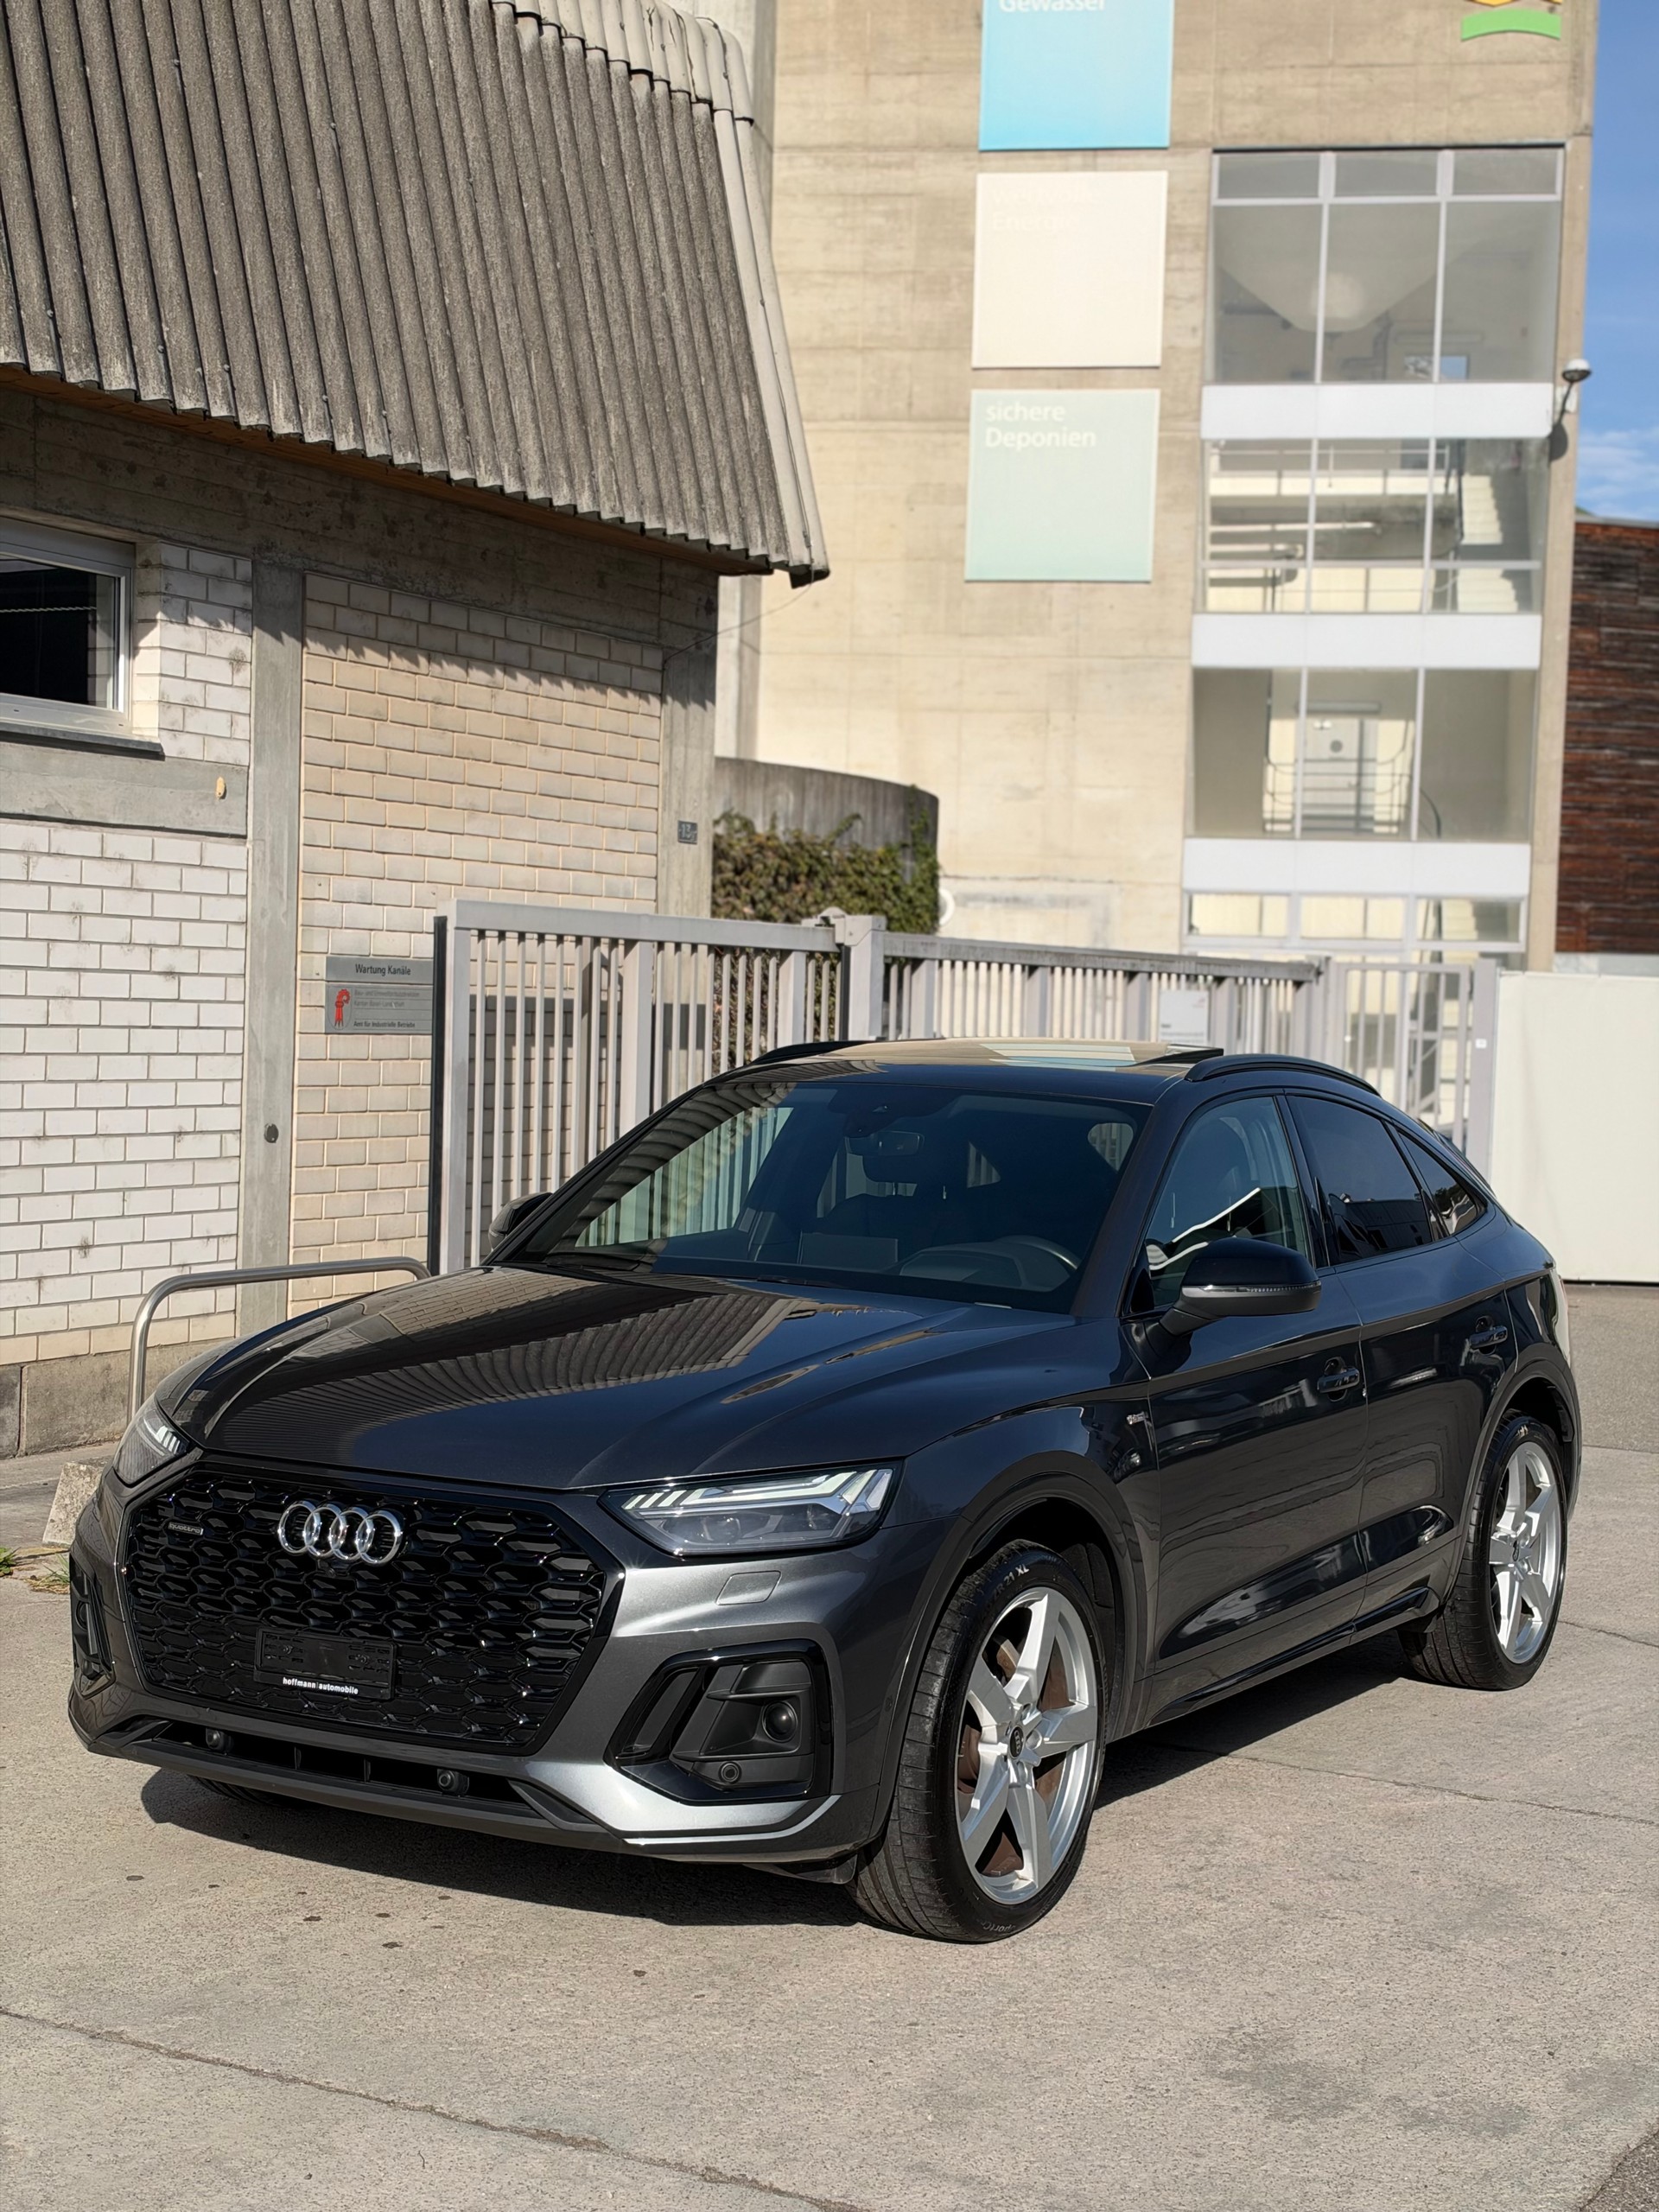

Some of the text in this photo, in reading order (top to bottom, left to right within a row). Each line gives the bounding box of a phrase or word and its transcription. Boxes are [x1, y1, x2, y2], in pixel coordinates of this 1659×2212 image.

[985, 401, 1066, 423] sichere
[984, 427, 1097, 452] Deponien
[355, 963, 411, 976] Wartung Kanäle
[169, 1522, 200, 1534] quattro
[1003, 1571, 1015, 1586] 21
[1014, 1563, 1030, 1577] XL
[283, 1676, 359, 1694] hoffmann automobile
